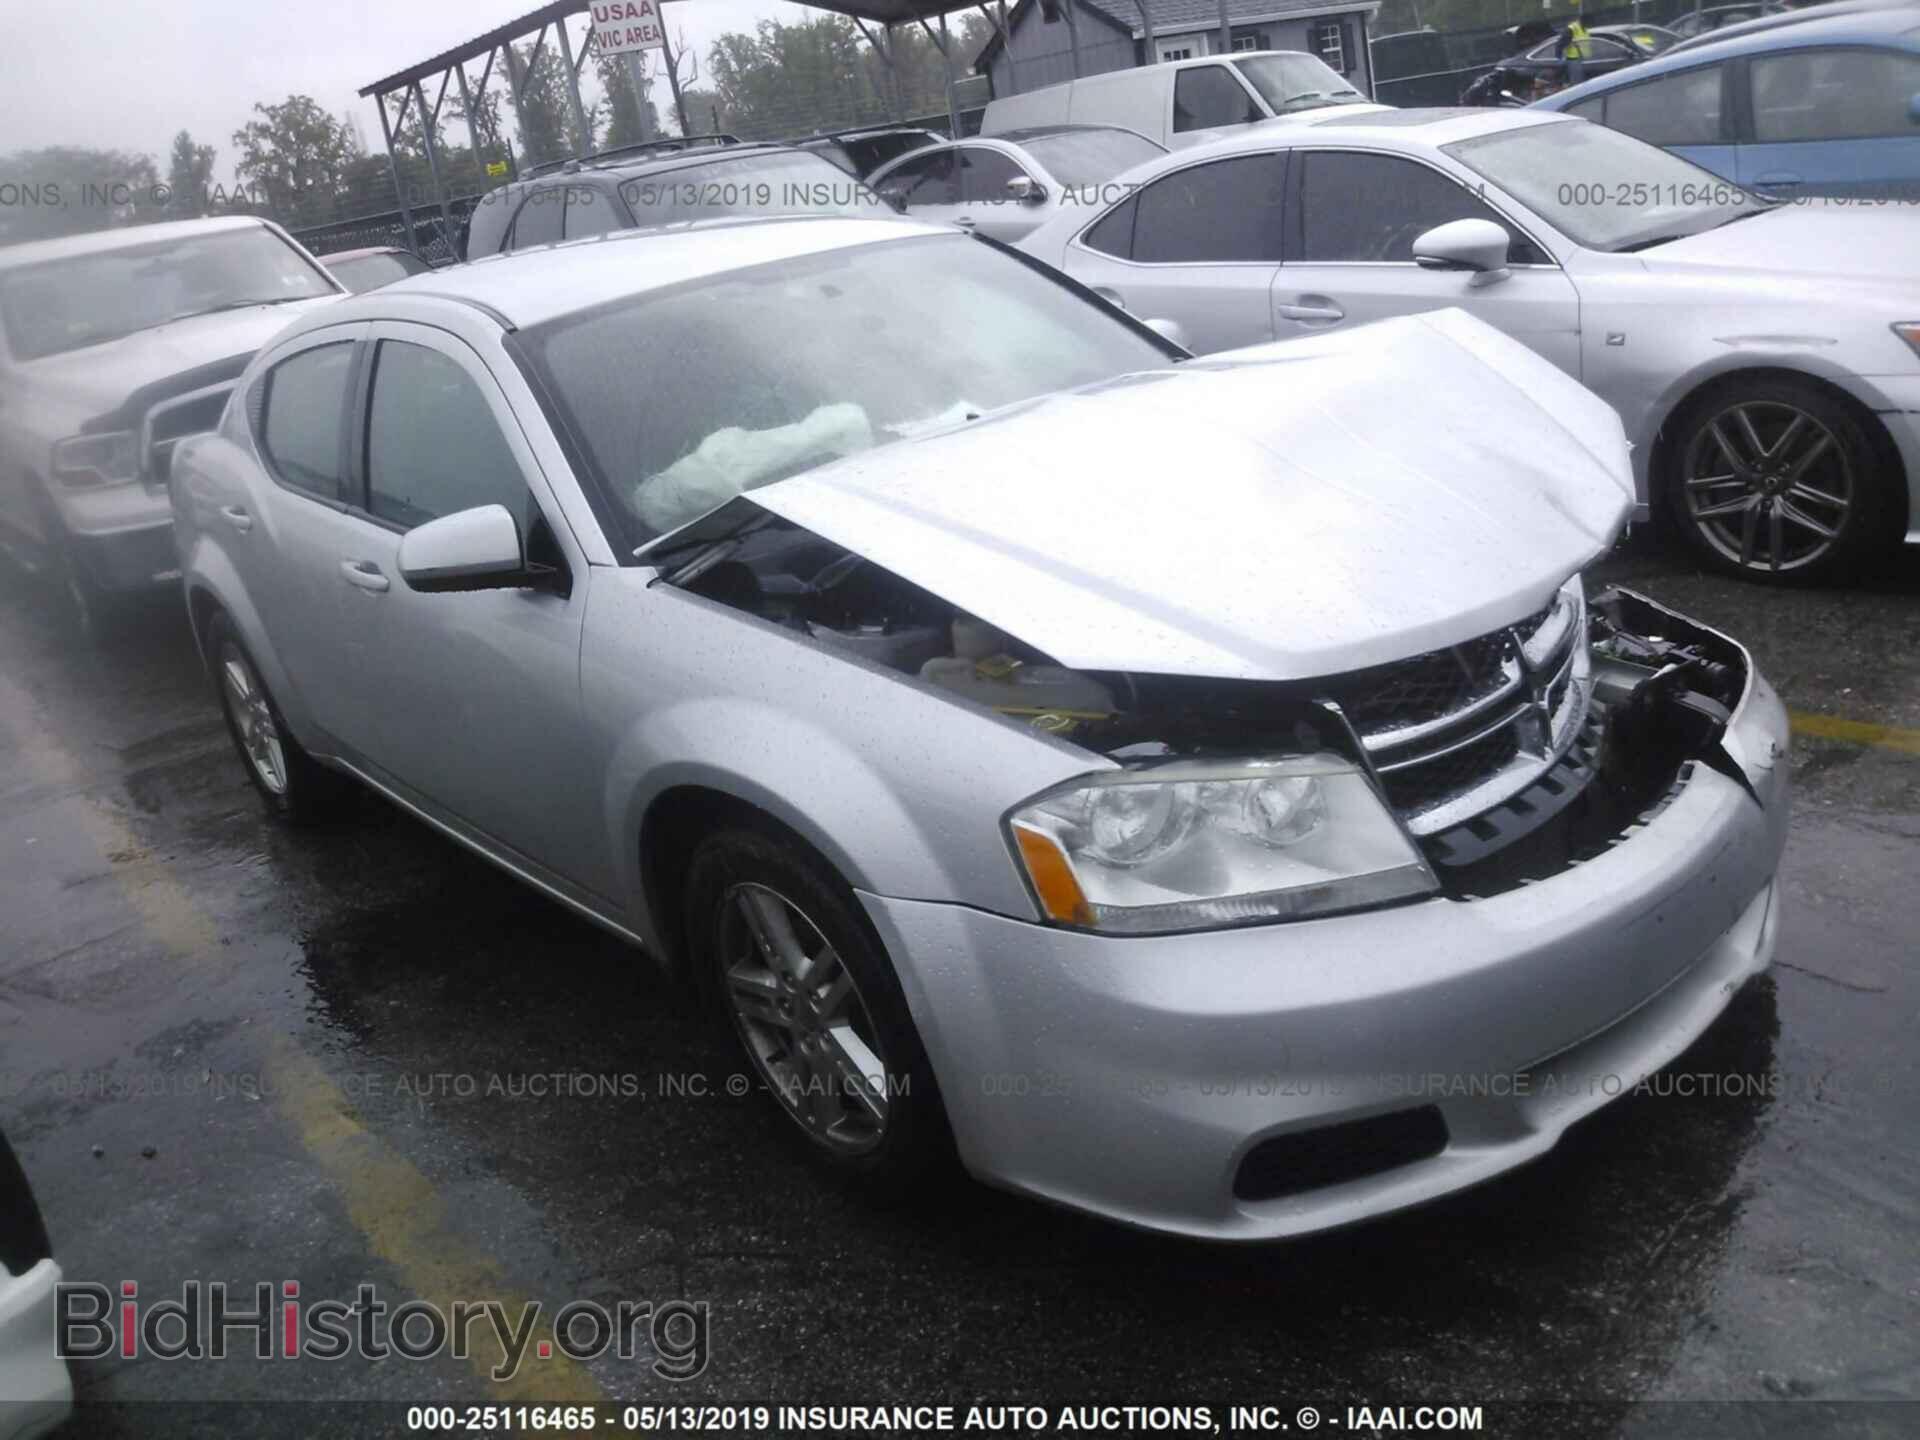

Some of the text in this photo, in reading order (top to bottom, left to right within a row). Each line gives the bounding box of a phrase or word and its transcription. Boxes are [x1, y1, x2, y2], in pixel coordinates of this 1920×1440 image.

[593, 0, 654, 22] USAA
[598, 25, 661, 48] VIC AREA
